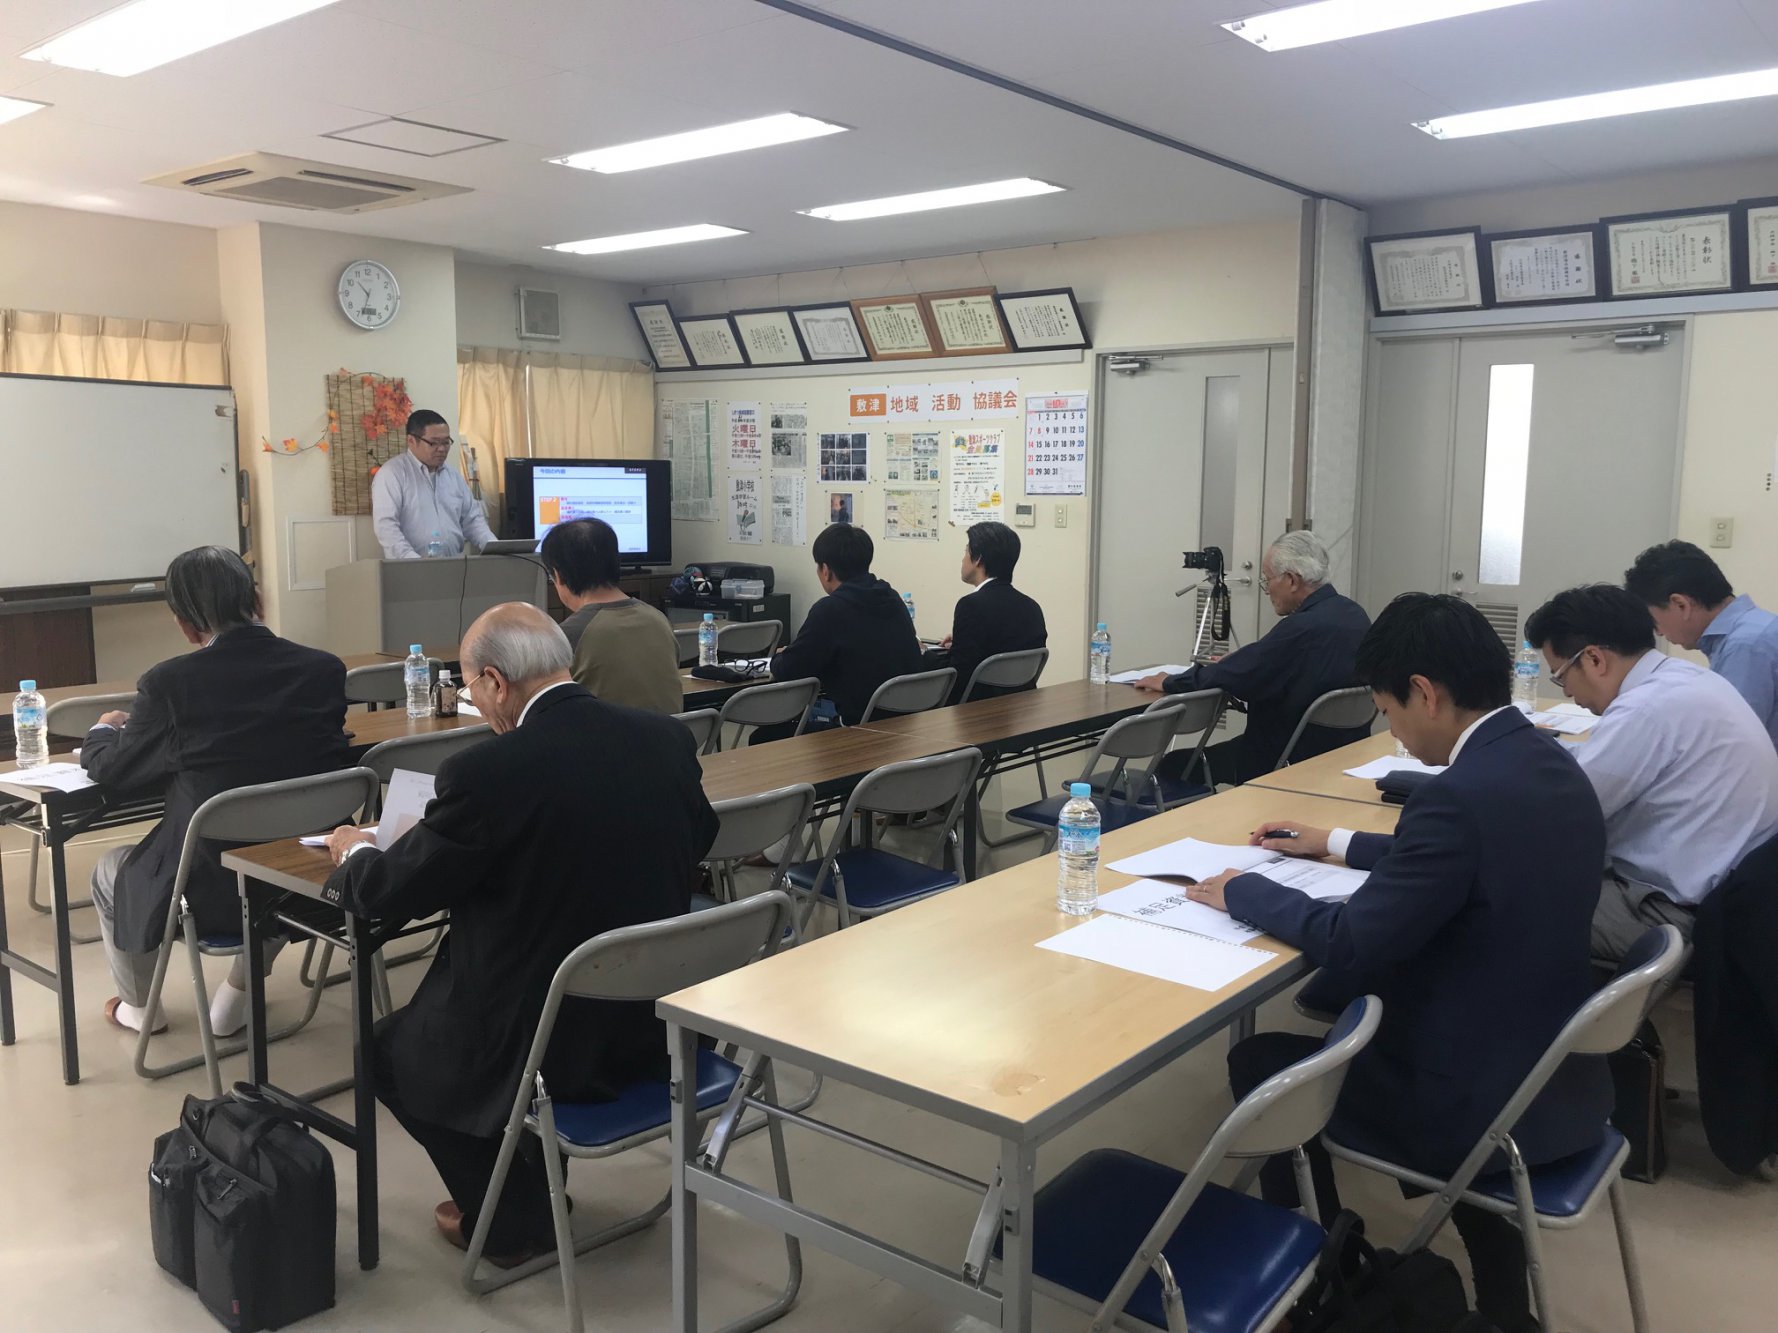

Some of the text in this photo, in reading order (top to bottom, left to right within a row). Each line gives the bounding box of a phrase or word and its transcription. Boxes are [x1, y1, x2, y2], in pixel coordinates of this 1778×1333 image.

[384, 281, 388, 289] 2
[856, 390, 1017, 413] 敷津 地域 活動 協議会
[1038, 413, 1041, 421] 1
[732, 424, 756, 433] 火曜日
[732, 440, 756, 448] 木曜日
